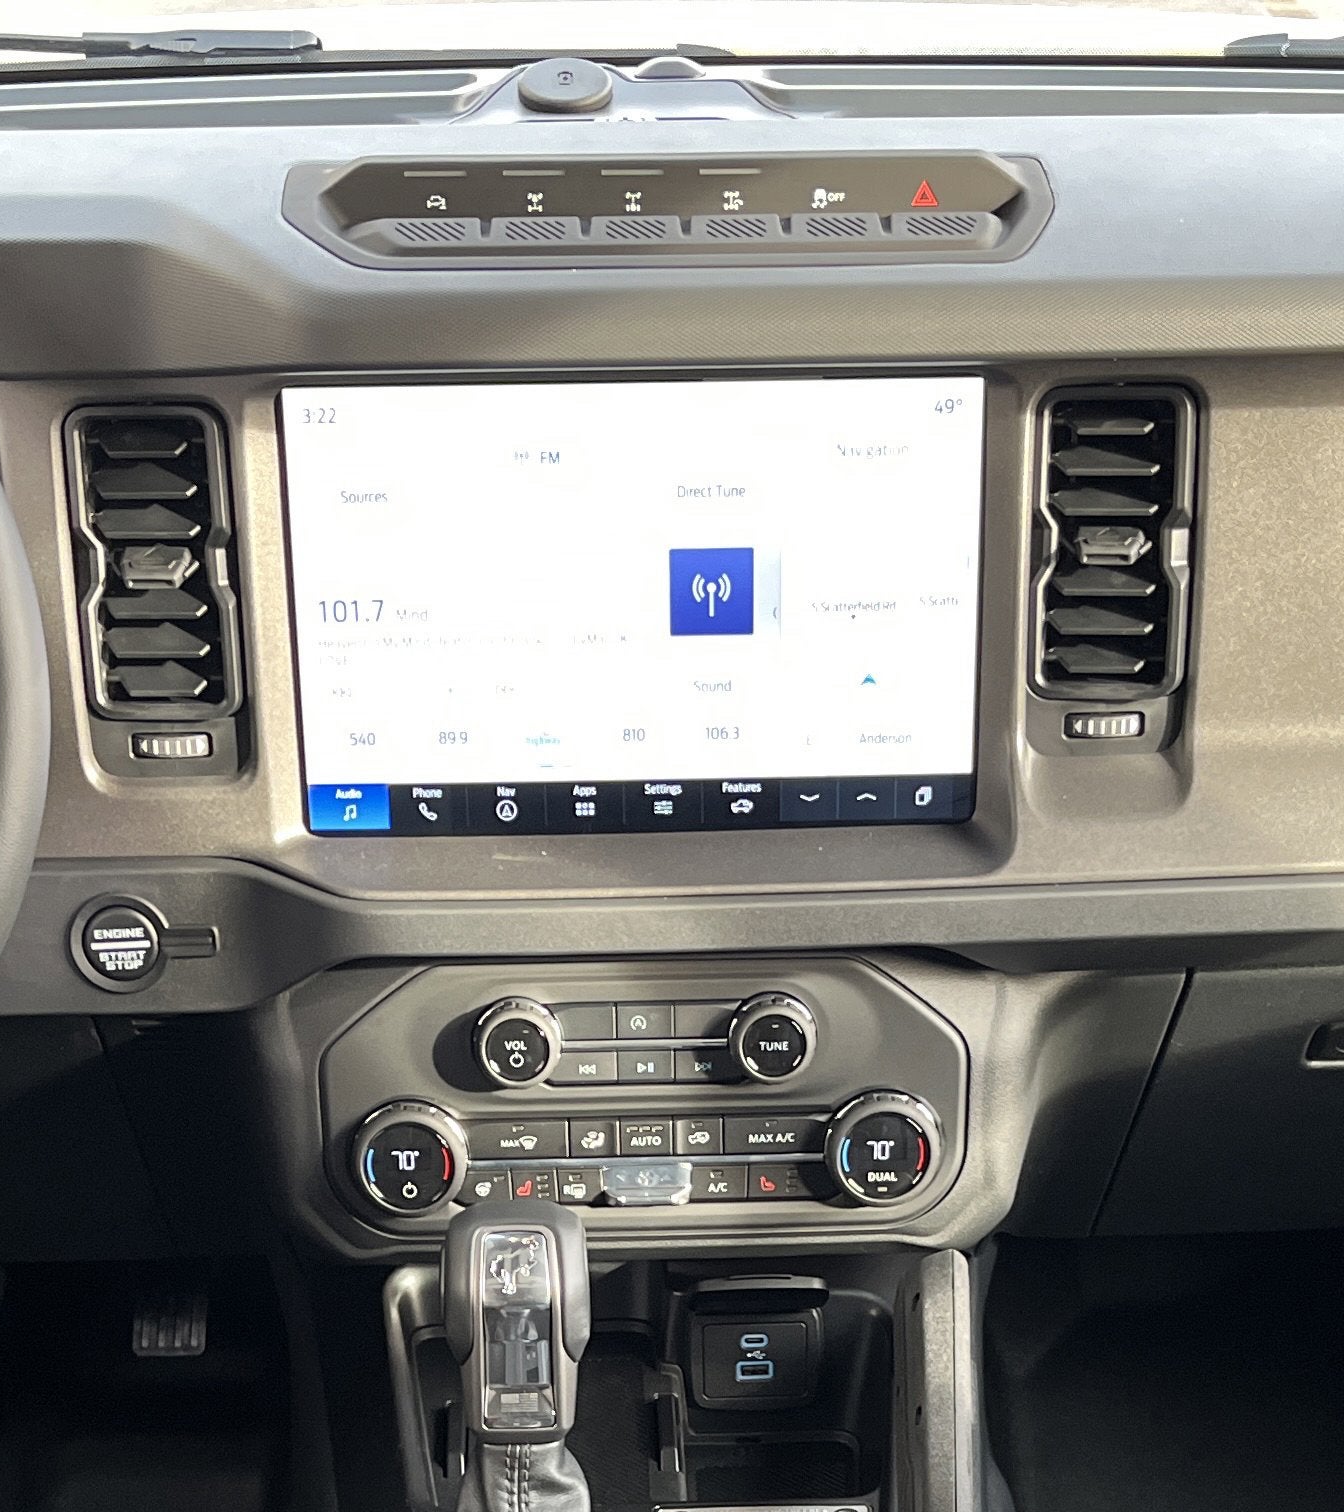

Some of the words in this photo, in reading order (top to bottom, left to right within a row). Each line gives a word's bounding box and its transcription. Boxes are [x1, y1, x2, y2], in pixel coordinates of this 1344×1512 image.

[302, 407, 337, 424] 3:22
[539, 451, 561, 465] FM
[340, 490, 388, 503] Sources
[677, 484, 712, 498] Direct
[715, 484, 746, 498] Tune
[318, 600, 384, 623] 101.7
[694, 680, 732, 693] Sound
[349, 732, 376, 746] 540
[622, 728, 646, 742] 810
[859, 733, 913, 745] Anderson
[335, 787, 363, 800] Audio
[412, 786, 443, 800] Phone
[496, 786, 516, 797] Nav
[573, 784, 597, 798] Apps
[644, 782, 683, 797] Settings
[721, 781, 762, 794] Features
[93, 927, 145, 940] ENGINE
[99, 951, 147, 963] START
[105, 960, 144, 972] STOP
[504, 1040, 528, 1051] VOL
[759, 1041, 789, 1052] TUNE
[500, 1138, 520, 1148] MAX
[630, 1135, 662, 1147] AUTO
[748, 1132, 774, 1143] MAX
[775, 1132, 796, 1144] A/C
[867, 1171, 898, 1183] DUAL
[707, 1182, 728, 1193] A/C
